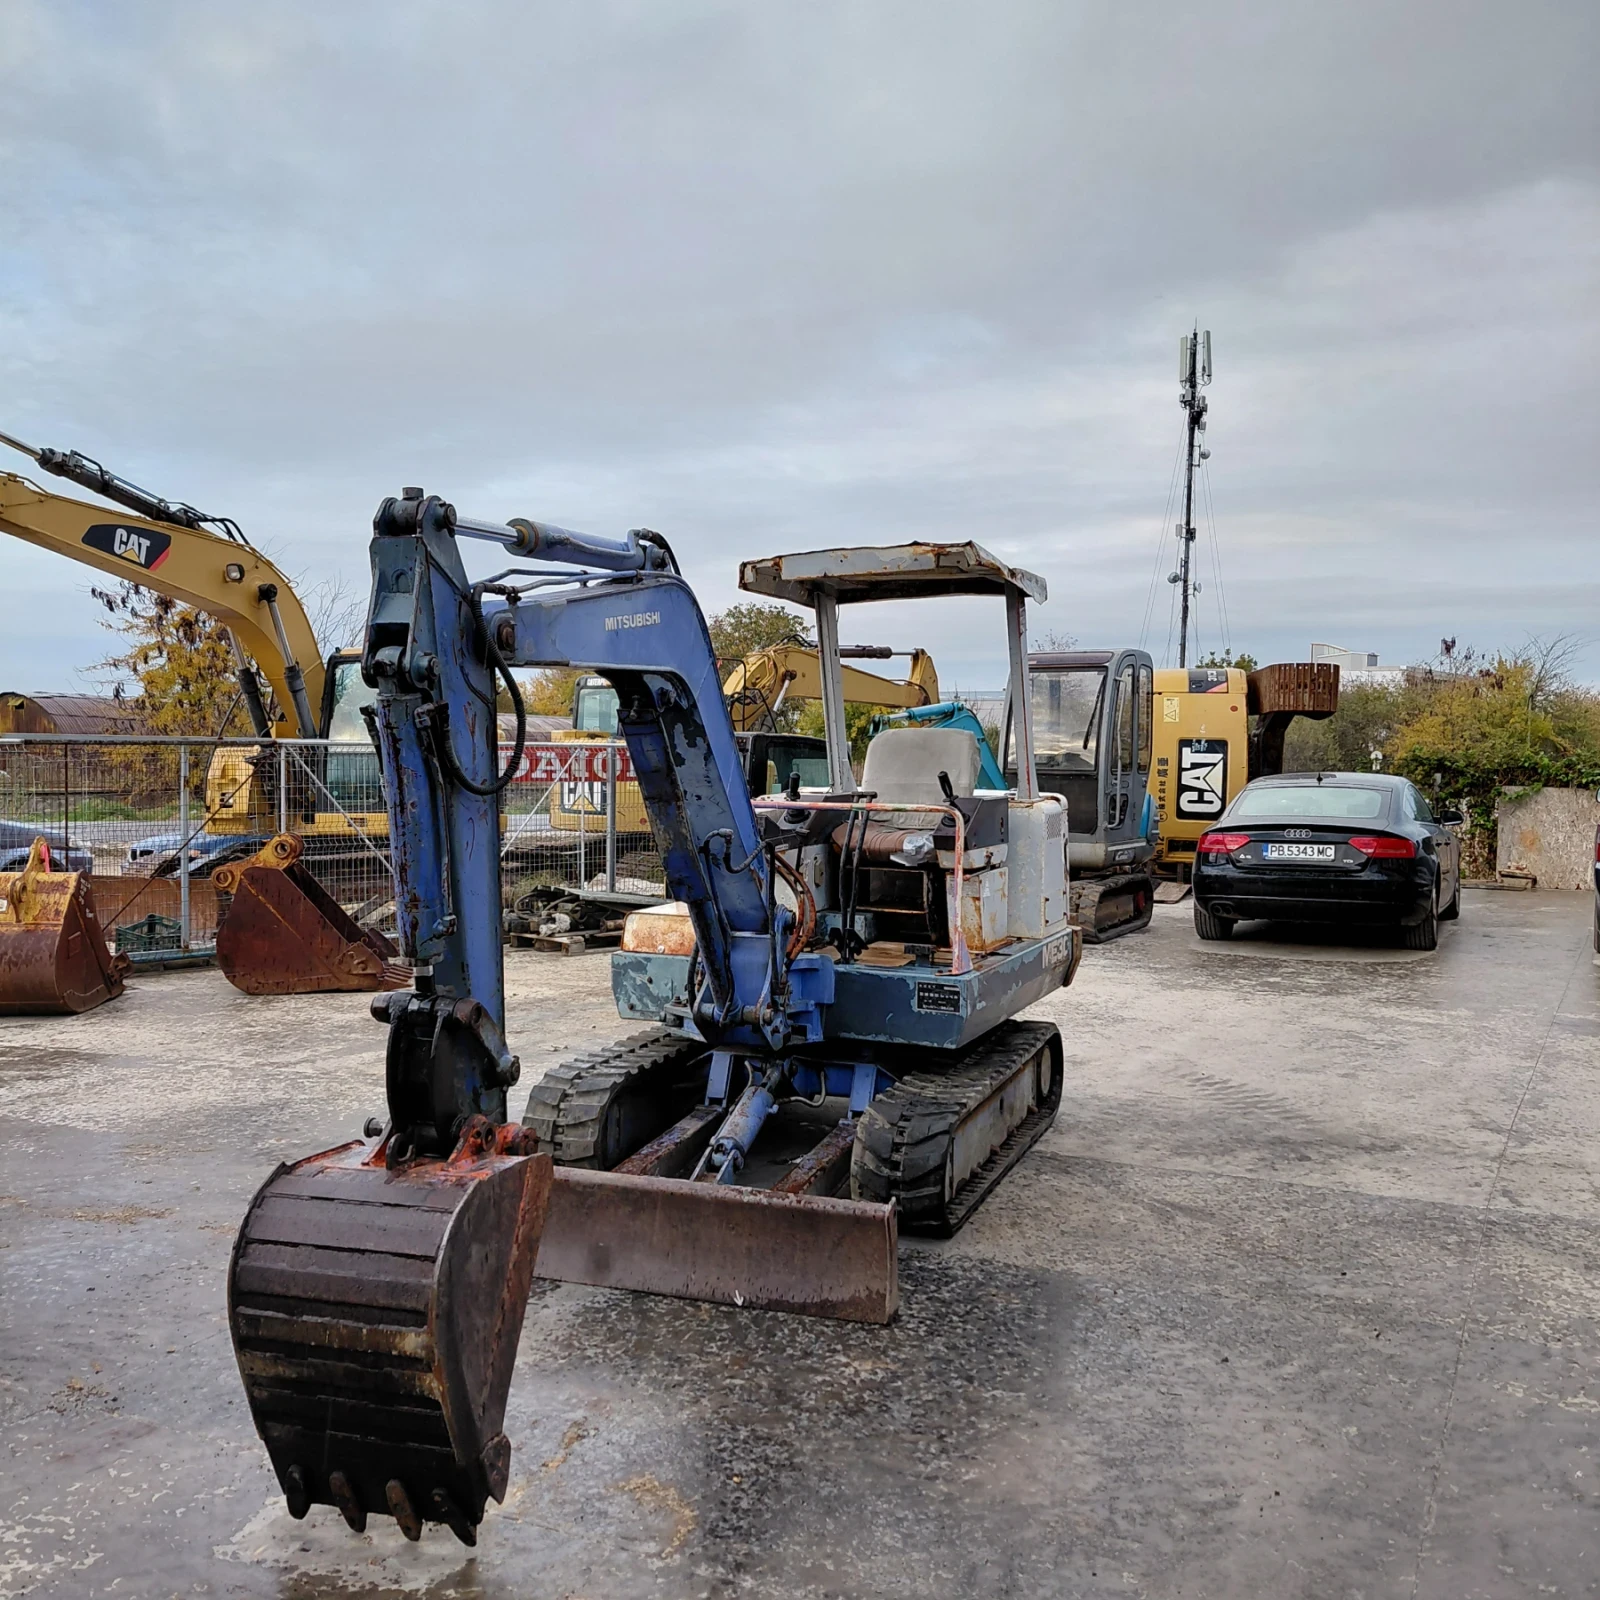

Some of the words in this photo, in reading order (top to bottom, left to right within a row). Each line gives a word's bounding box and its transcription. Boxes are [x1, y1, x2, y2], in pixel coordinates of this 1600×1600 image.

[113, 528, 151, 565] CAT
[604, 611, 661, 631] MITSUBISHI
[1179, 747, 1224, 813] CAT
[1317, 846, 1333, 858] MC
